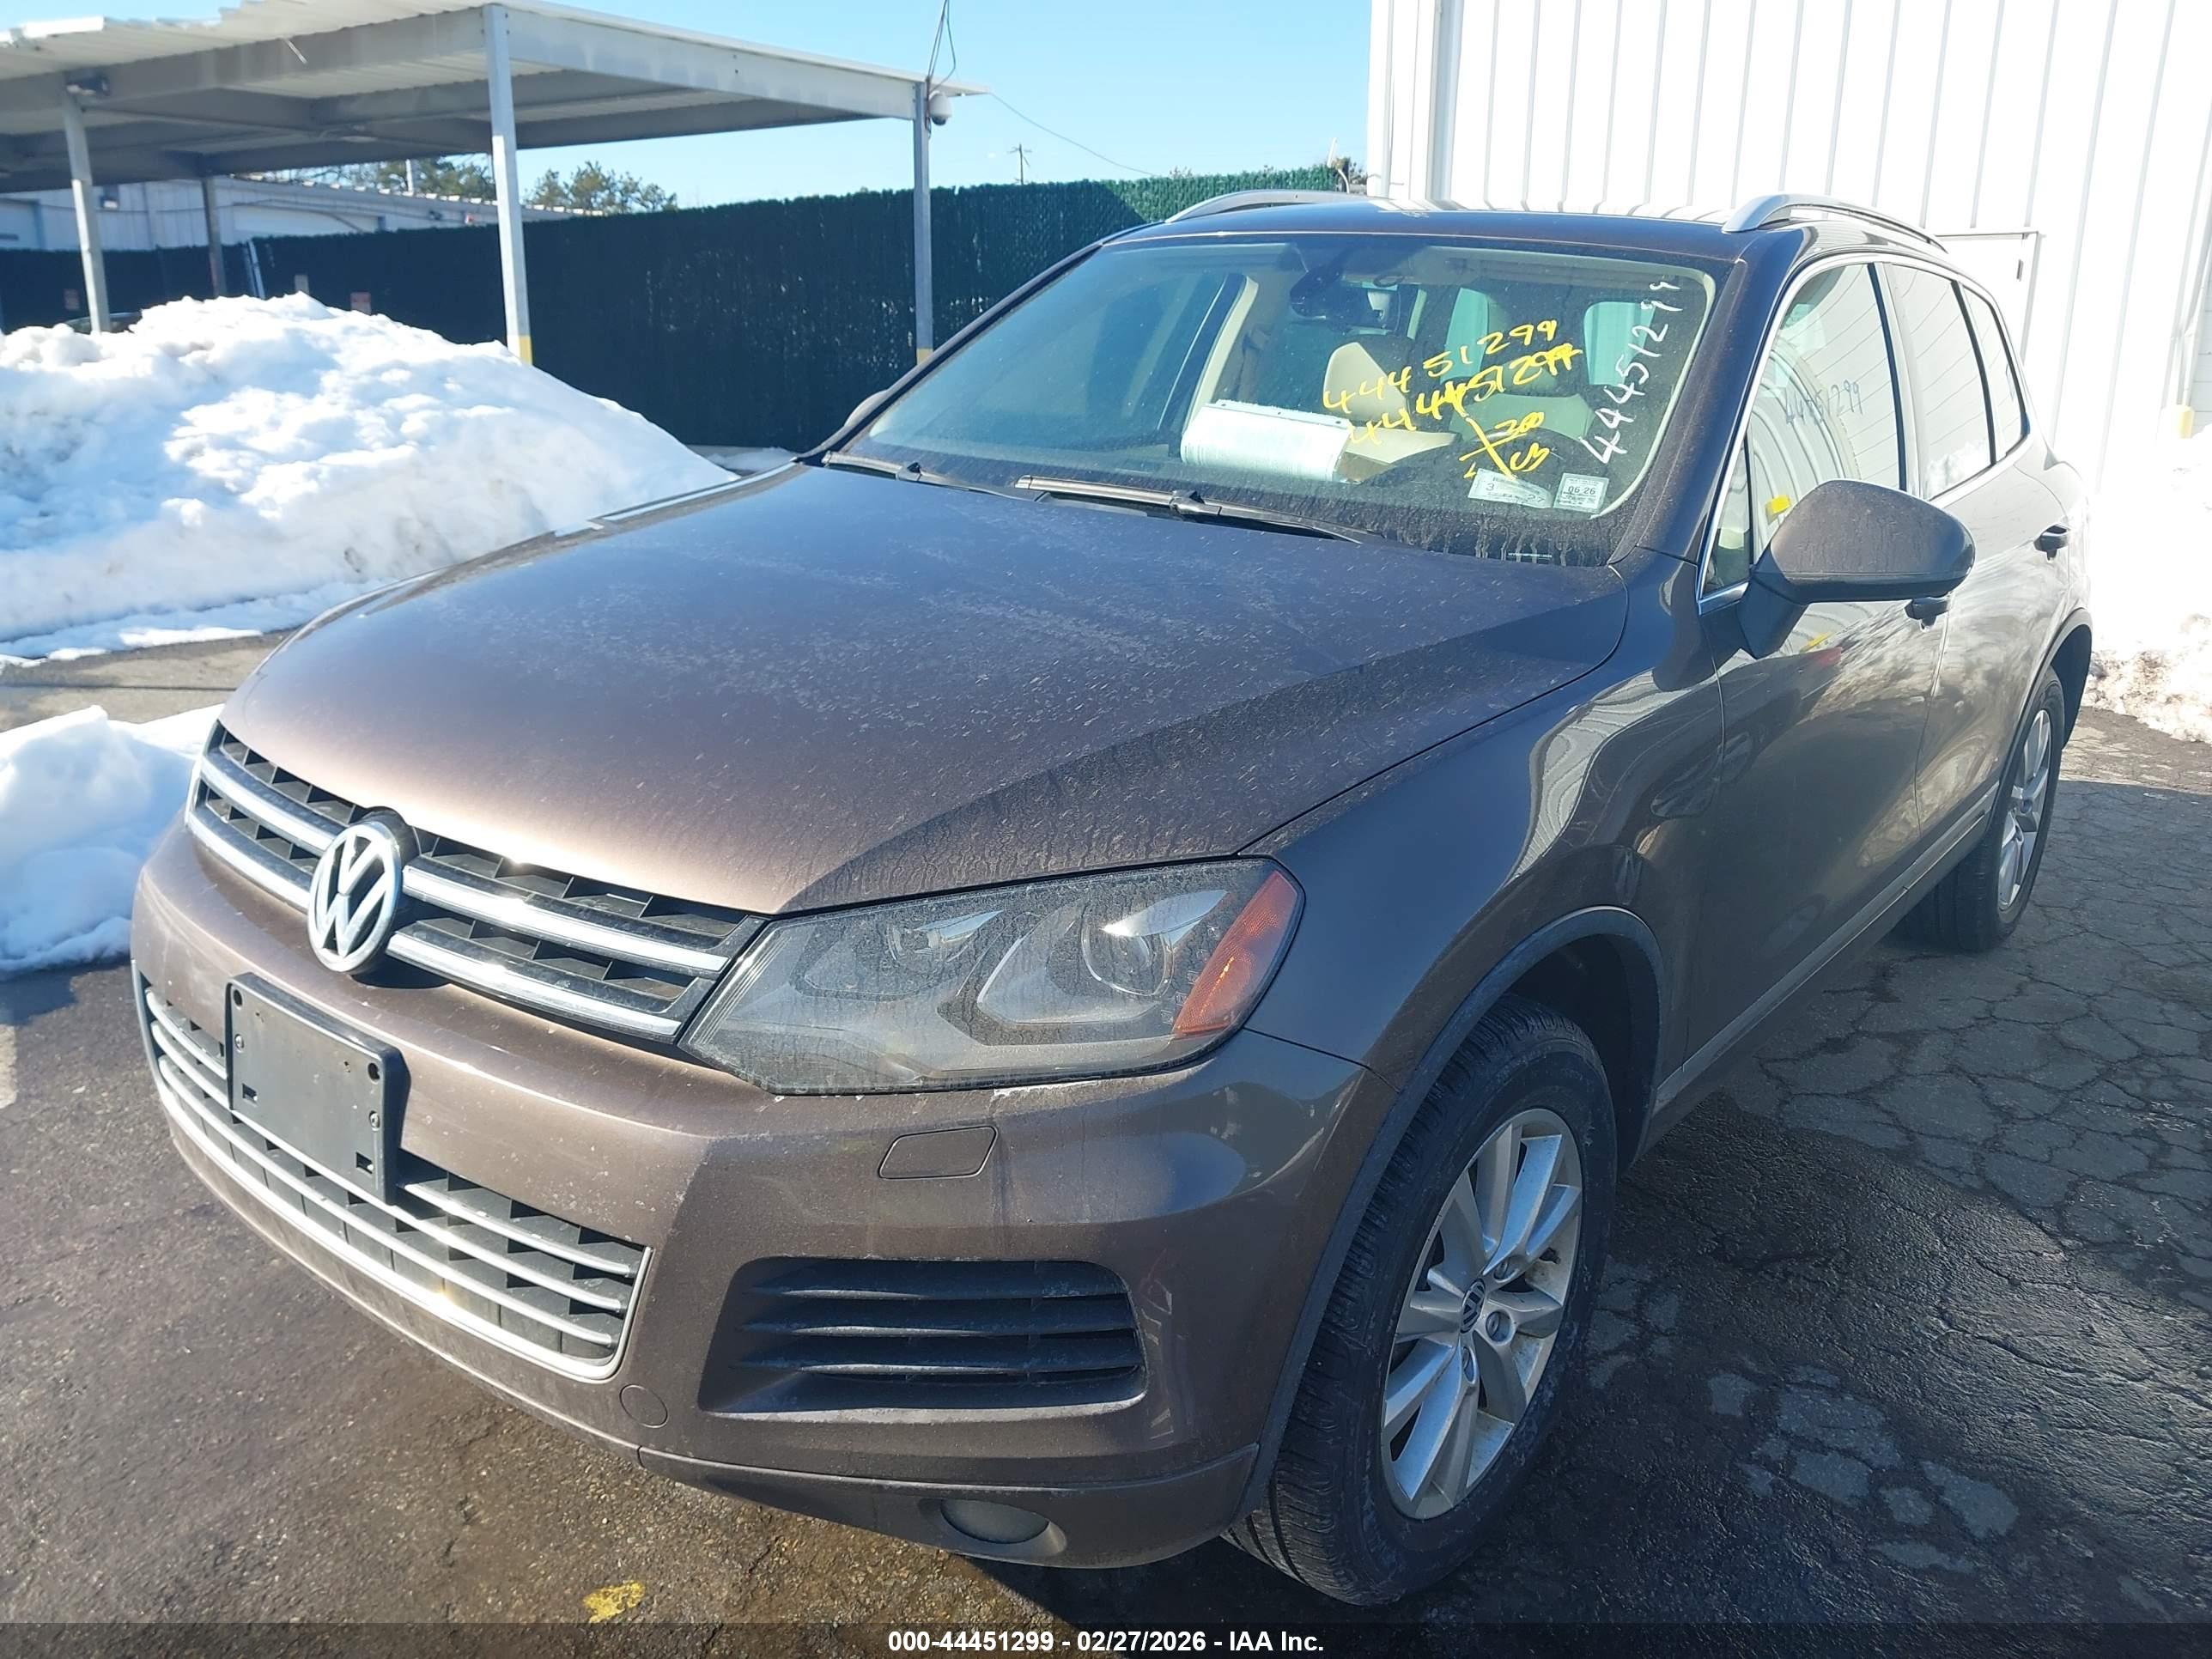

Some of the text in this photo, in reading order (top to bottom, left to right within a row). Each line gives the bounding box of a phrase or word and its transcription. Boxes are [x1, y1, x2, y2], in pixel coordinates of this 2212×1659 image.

[1578, 281, 1683, 465] 44451299
[1568, 485, 1595, 495] 06 26
[309, 823, 397, 970] VW
